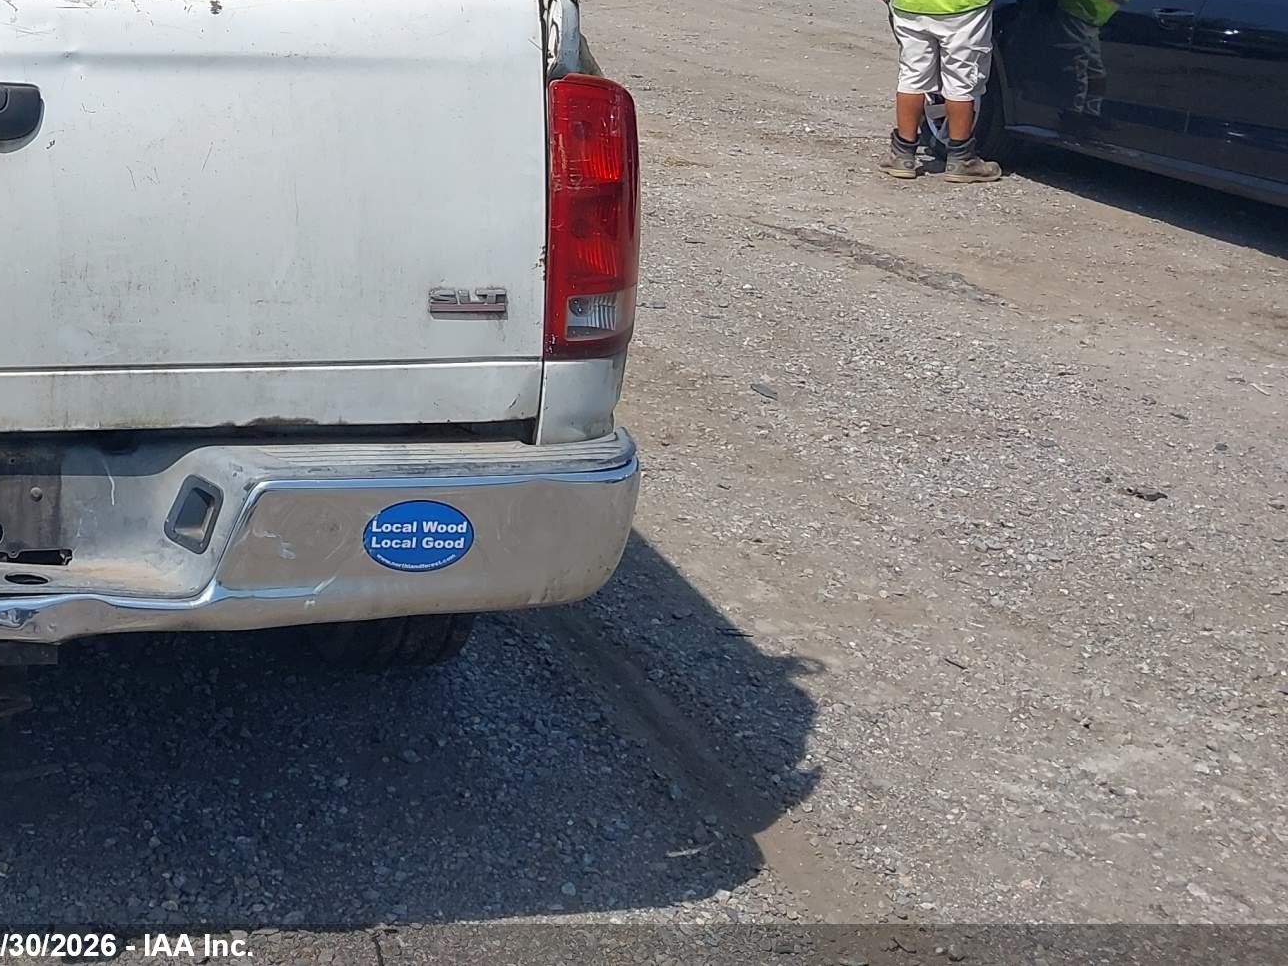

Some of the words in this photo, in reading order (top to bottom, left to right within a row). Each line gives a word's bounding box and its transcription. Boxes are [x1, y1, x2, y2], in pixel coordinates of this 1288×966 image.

[371, 520, 418, 533] Local
[422, 521, 467, 533] Wood
[371, 536, 417, 548] Local
[421, 537, 465, 549] Good
